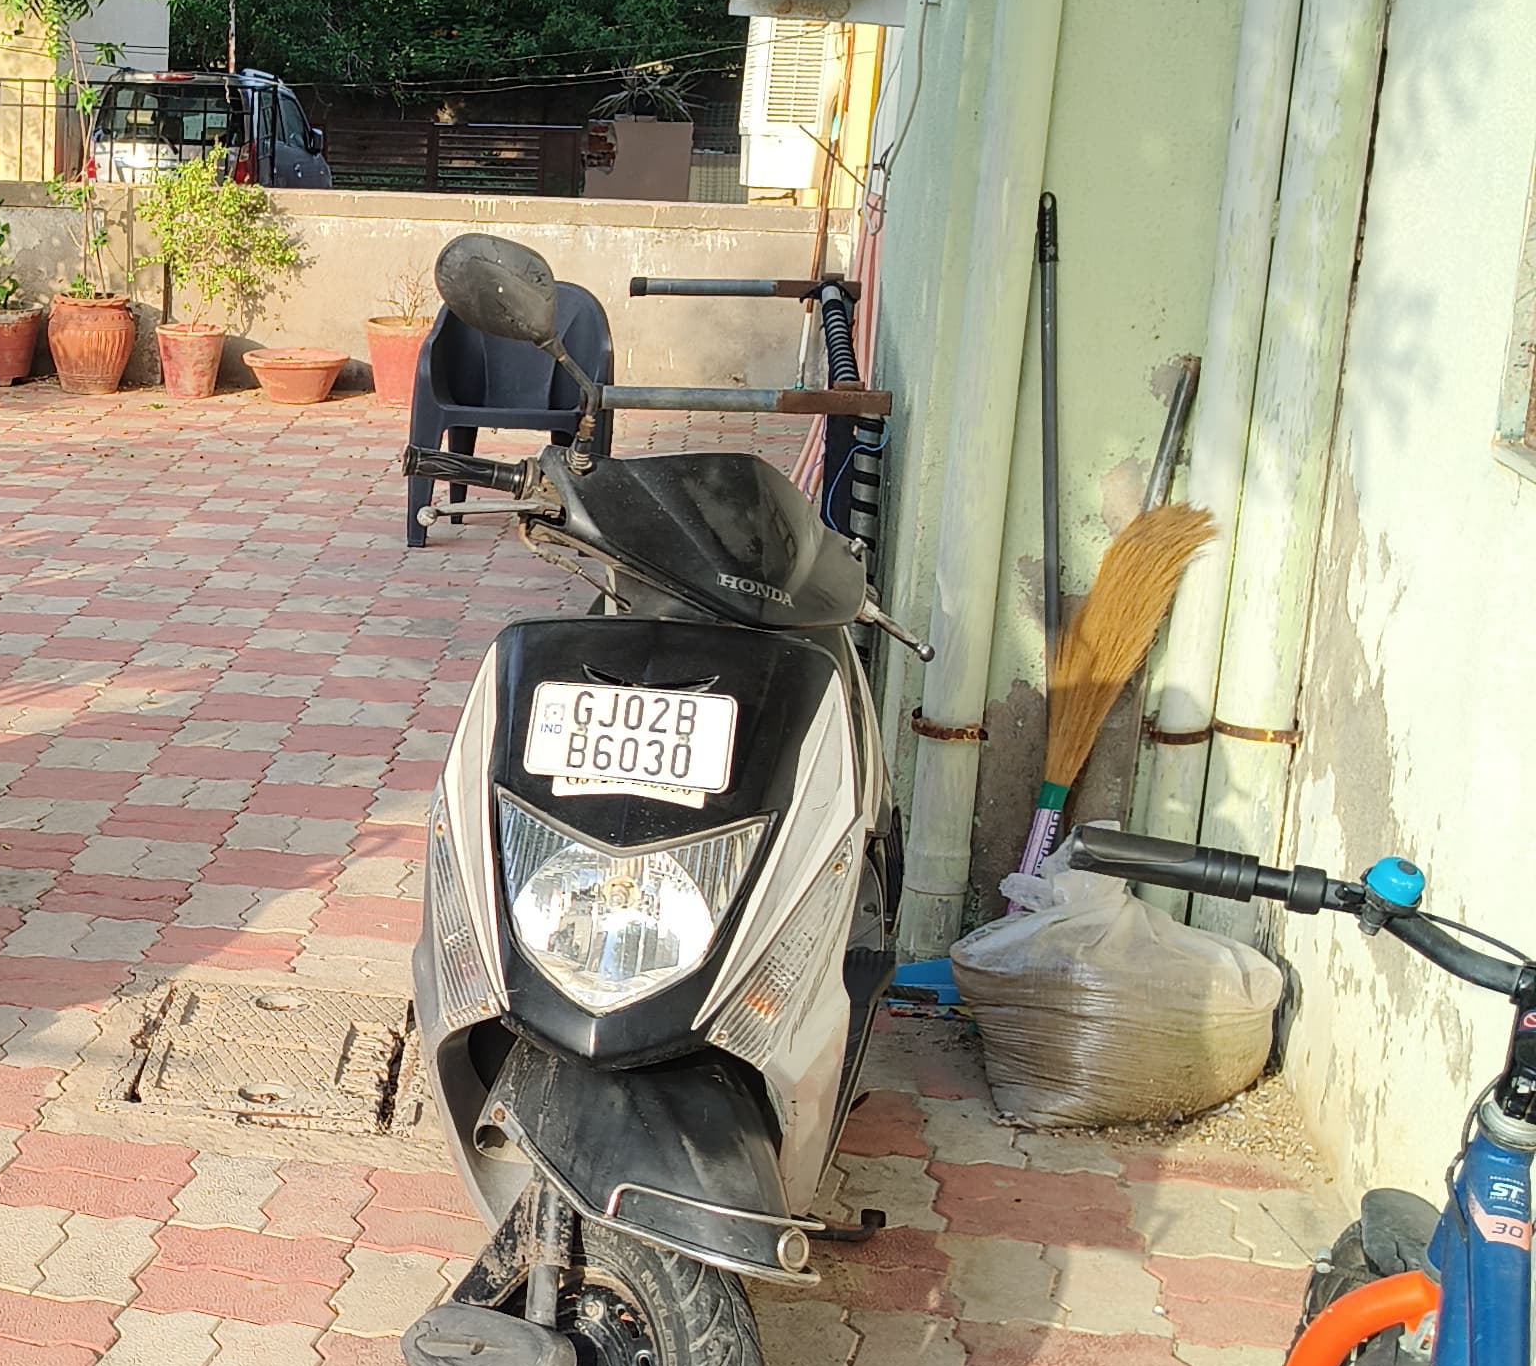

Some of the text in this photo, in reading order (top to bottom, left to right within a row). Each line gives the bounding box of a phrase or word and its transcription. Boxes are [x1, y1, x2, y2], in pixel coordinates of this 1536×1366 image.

[717, 572, 795, 608] HONDA
[573, 690, 697, 735] GJ02B
[566, 732, 692, 778] B6030
[1489, 1182, 1525, 1199] ST
[1491, 1221, 1524, 1239] 30
